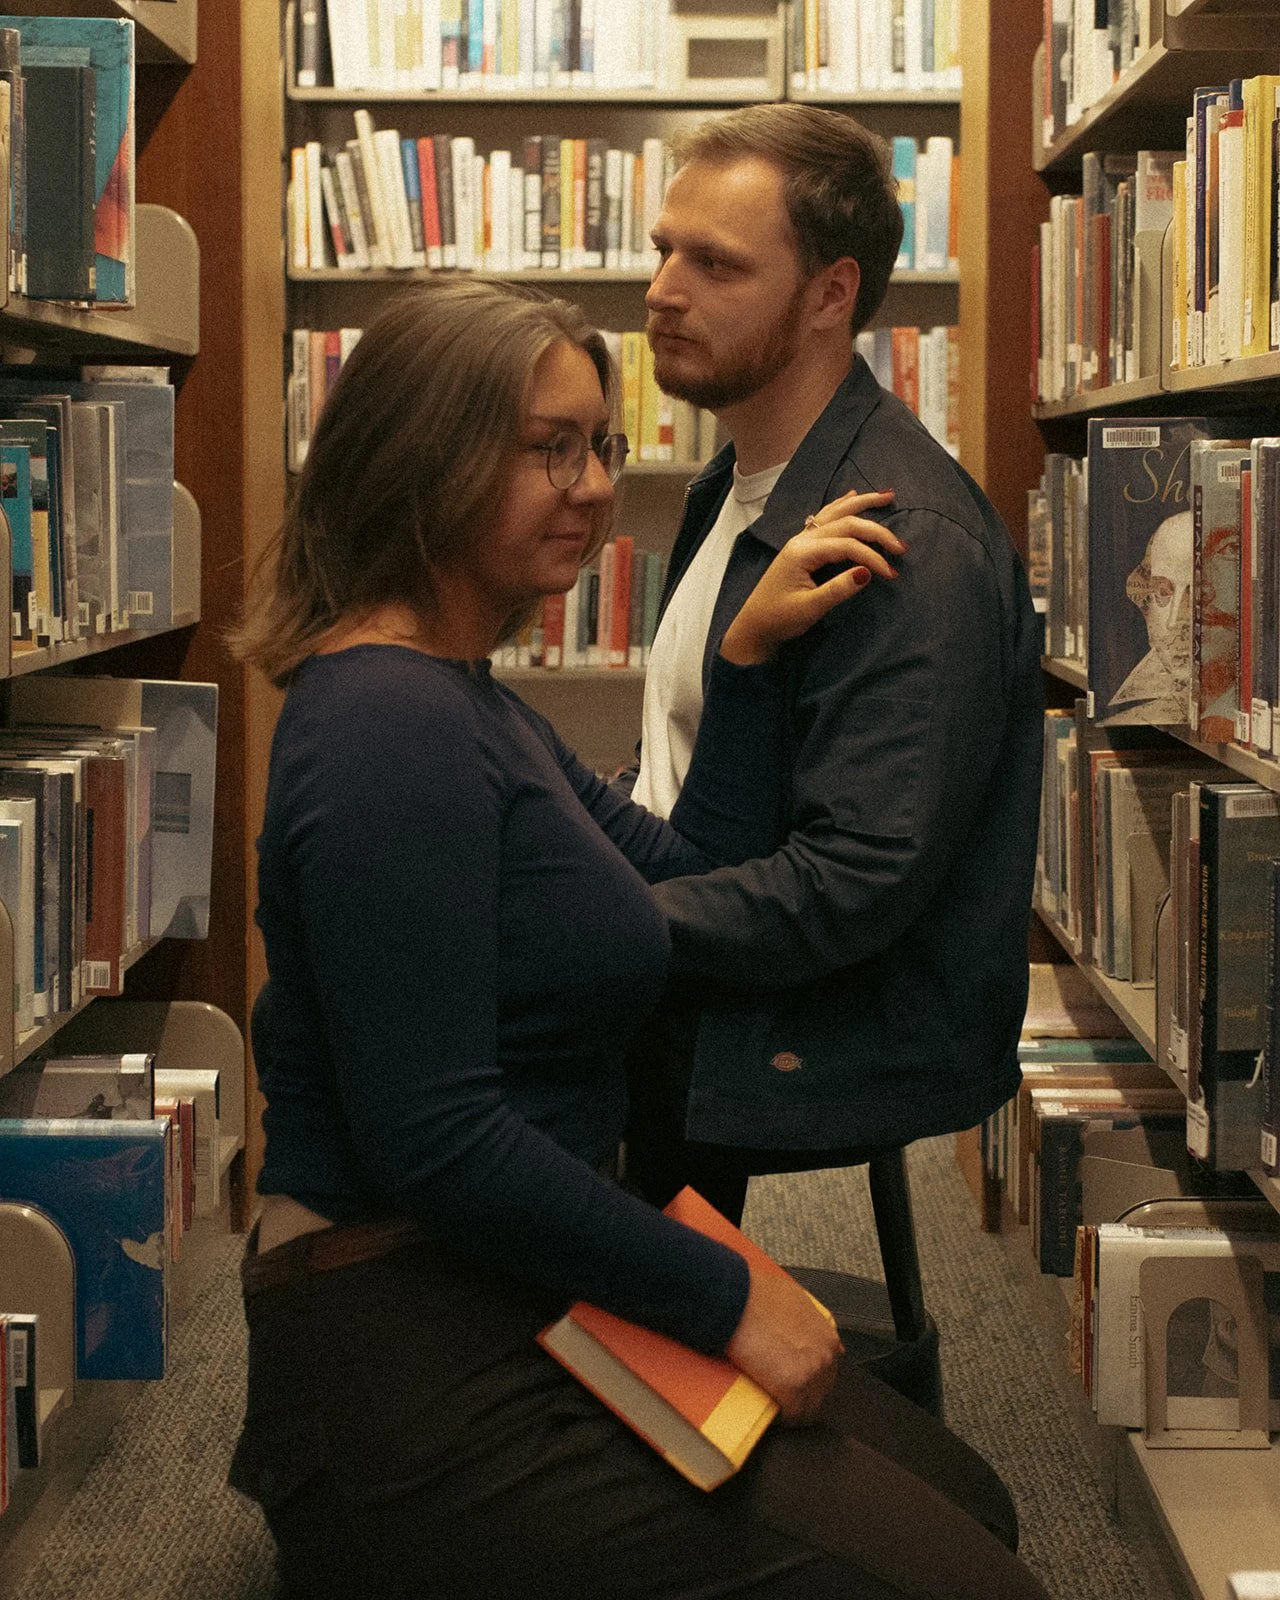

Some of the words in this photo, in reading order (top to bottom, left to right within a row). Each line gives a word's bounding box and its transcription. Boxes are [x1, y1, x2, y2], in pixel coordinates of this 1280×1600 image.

[1123, 443, 1190, 503] Sh
[1201, 864, 1209, 939] SHAKESPEARE'S
[1129, 1295, 1141, 1332] Emma
[1129, 1335, 1144, 1369] Smith
